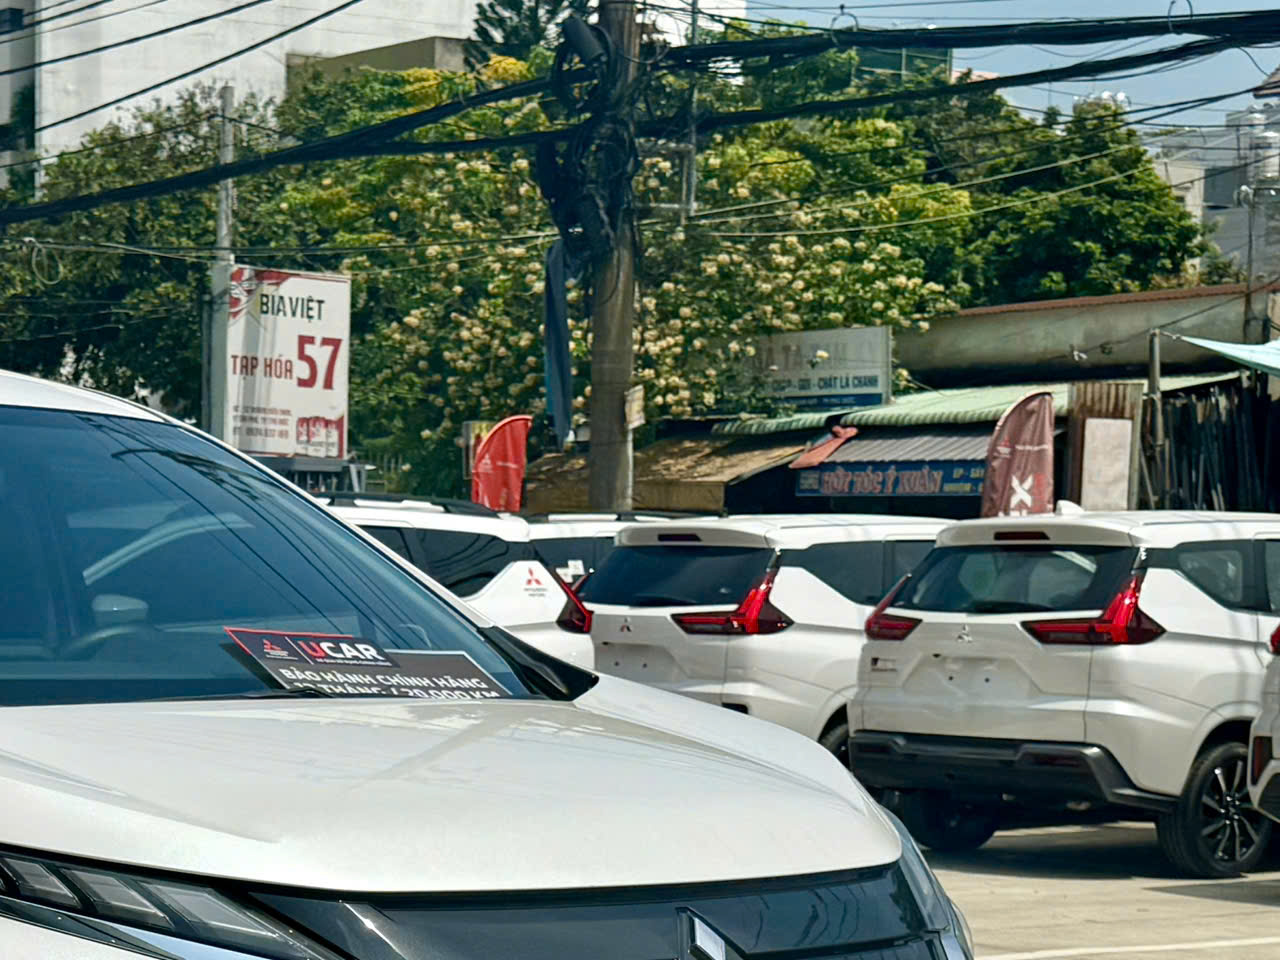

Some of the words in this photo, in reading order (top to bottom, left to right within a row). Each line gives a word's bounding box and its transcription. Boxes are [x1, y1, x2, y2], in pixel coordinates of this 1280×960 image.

[260, 293, 287, 317] BIA
[289, 296, 325, 323] VIỆT
[231, 355, 259, 380] TẠP
[264, 354, 293, 380] HÓA
[297, 334, 343, 390] 57
[298, 640, 386, 660] UCAR
[279, 666, 320, 682] BẢO
[320, 668, 373, 685] HÀNH
[376, 673, 433, 688] CHÍNH
[433, 676, 488, 690] HÃNG
